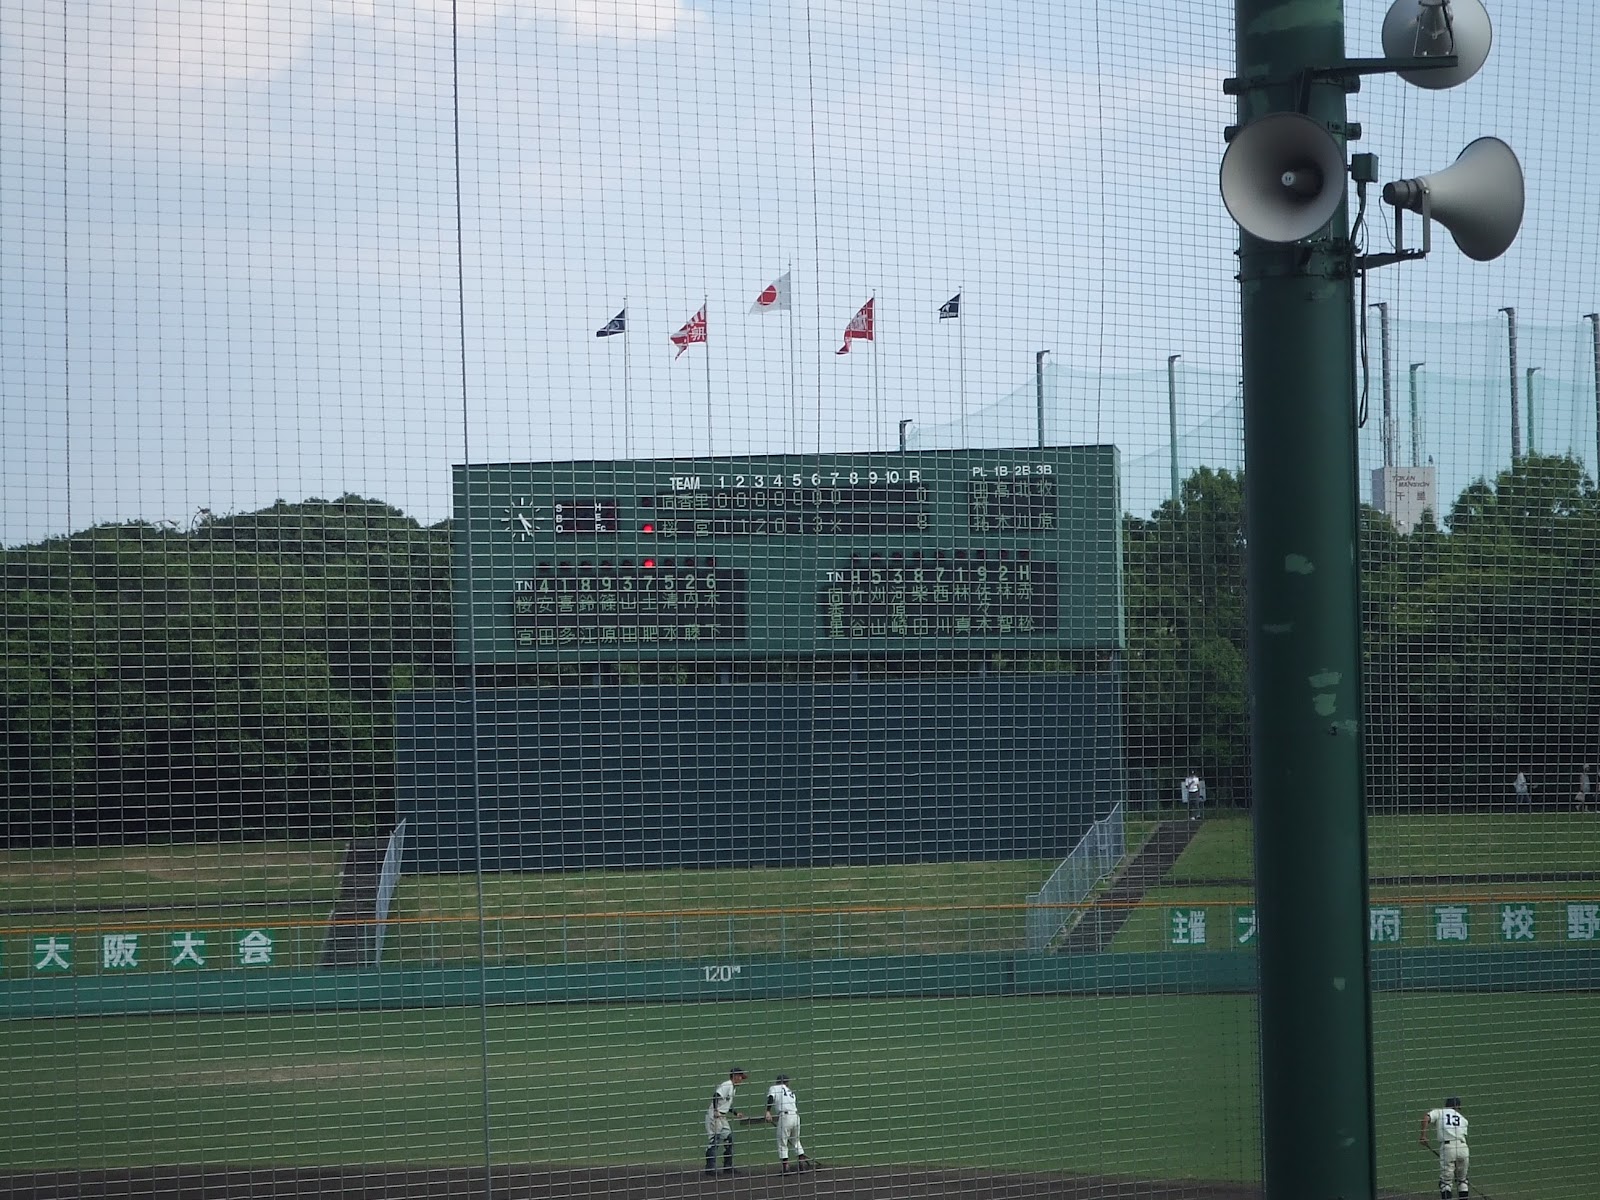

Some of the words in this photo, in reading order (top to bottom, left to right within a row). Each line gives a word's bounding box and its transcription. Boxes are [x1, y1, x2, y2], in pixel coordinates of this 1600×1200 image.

[670, 476, 700, 490] TEAM
[719, 476, 725, 488] 1
[736, 476, 745, 488] 2
[754, 476, 764, 488] 3
[773, 474, 783, 486] 4
[792, 474, 802, 486] 5
[811, 474, 820, 486] 6
[830, 472, 840, 486] 7
[850, 472, 859, 484] 8
[868, 472, 878, 484] 9
[885, 471, 900, 484] 10
[909, 470, 920, 483] R
[972, 466, 988, 476] PL
[994, 466, 1008, 476] 1B
[1014, 466, 1030, 476] 2B
[1036, 464, 1052, 474] 3B
[556, 504, 562, 512] S
[595, 503, 602, 512] H
[718, 492, 728, 508] 0
[736, 492, 746, 508] 0
[756, 491, 766, 507] 0
[774, 490, 784, 506] 0
[831, 488, 841, 504] 0
[916, 487, 926, 502] 0
[556, 514, 562, 523] B
[595, 514, 602, 522] E
[774, 518, 784, 532] 0
[812, 516, 823, 532] 3
[516, 580, 533, 590] TN
[539, 578, 548, 593] 4
[560, 578, 568, 592] 1
[580, 578, 590, 591] 8
[601, 577, 612, 590] 9
[622, 576, 632, 590] 3
[643, 576, 653, 590] 7
[664, 574, 674, 590] 5
[686, 574, 695, 590] 2
[706, 574, 716, 589] 6
[826, 572, 844, 582] TN
[872, 570, 882, 584] 5
[893, 569, 903, 583] 3
[914, 568, 924, 582] 8
[935, 566, 944, 582] 7
[956, 566, 962, 582] 1
[978, 566, 987, 582] 9
[998, 566, 1008, 581] 2
[1020, 565, 1029, 580] H
[516, 596, 533, 646] 桜宮
[537, 595, 553, 646] 安田
[558, 595, 576, 645] 喜多
[580, 594, 598, 644] 鈴江
[622, 593, 637, 643] 山田
[642, 592, 658, 642] 土肥
[704, 590, 721, 640] 木下
[912, 585, 928, 635] 柴田
[934, 585, 949, 634] 西川
[1446, 1114, 1460, 1126] 13
